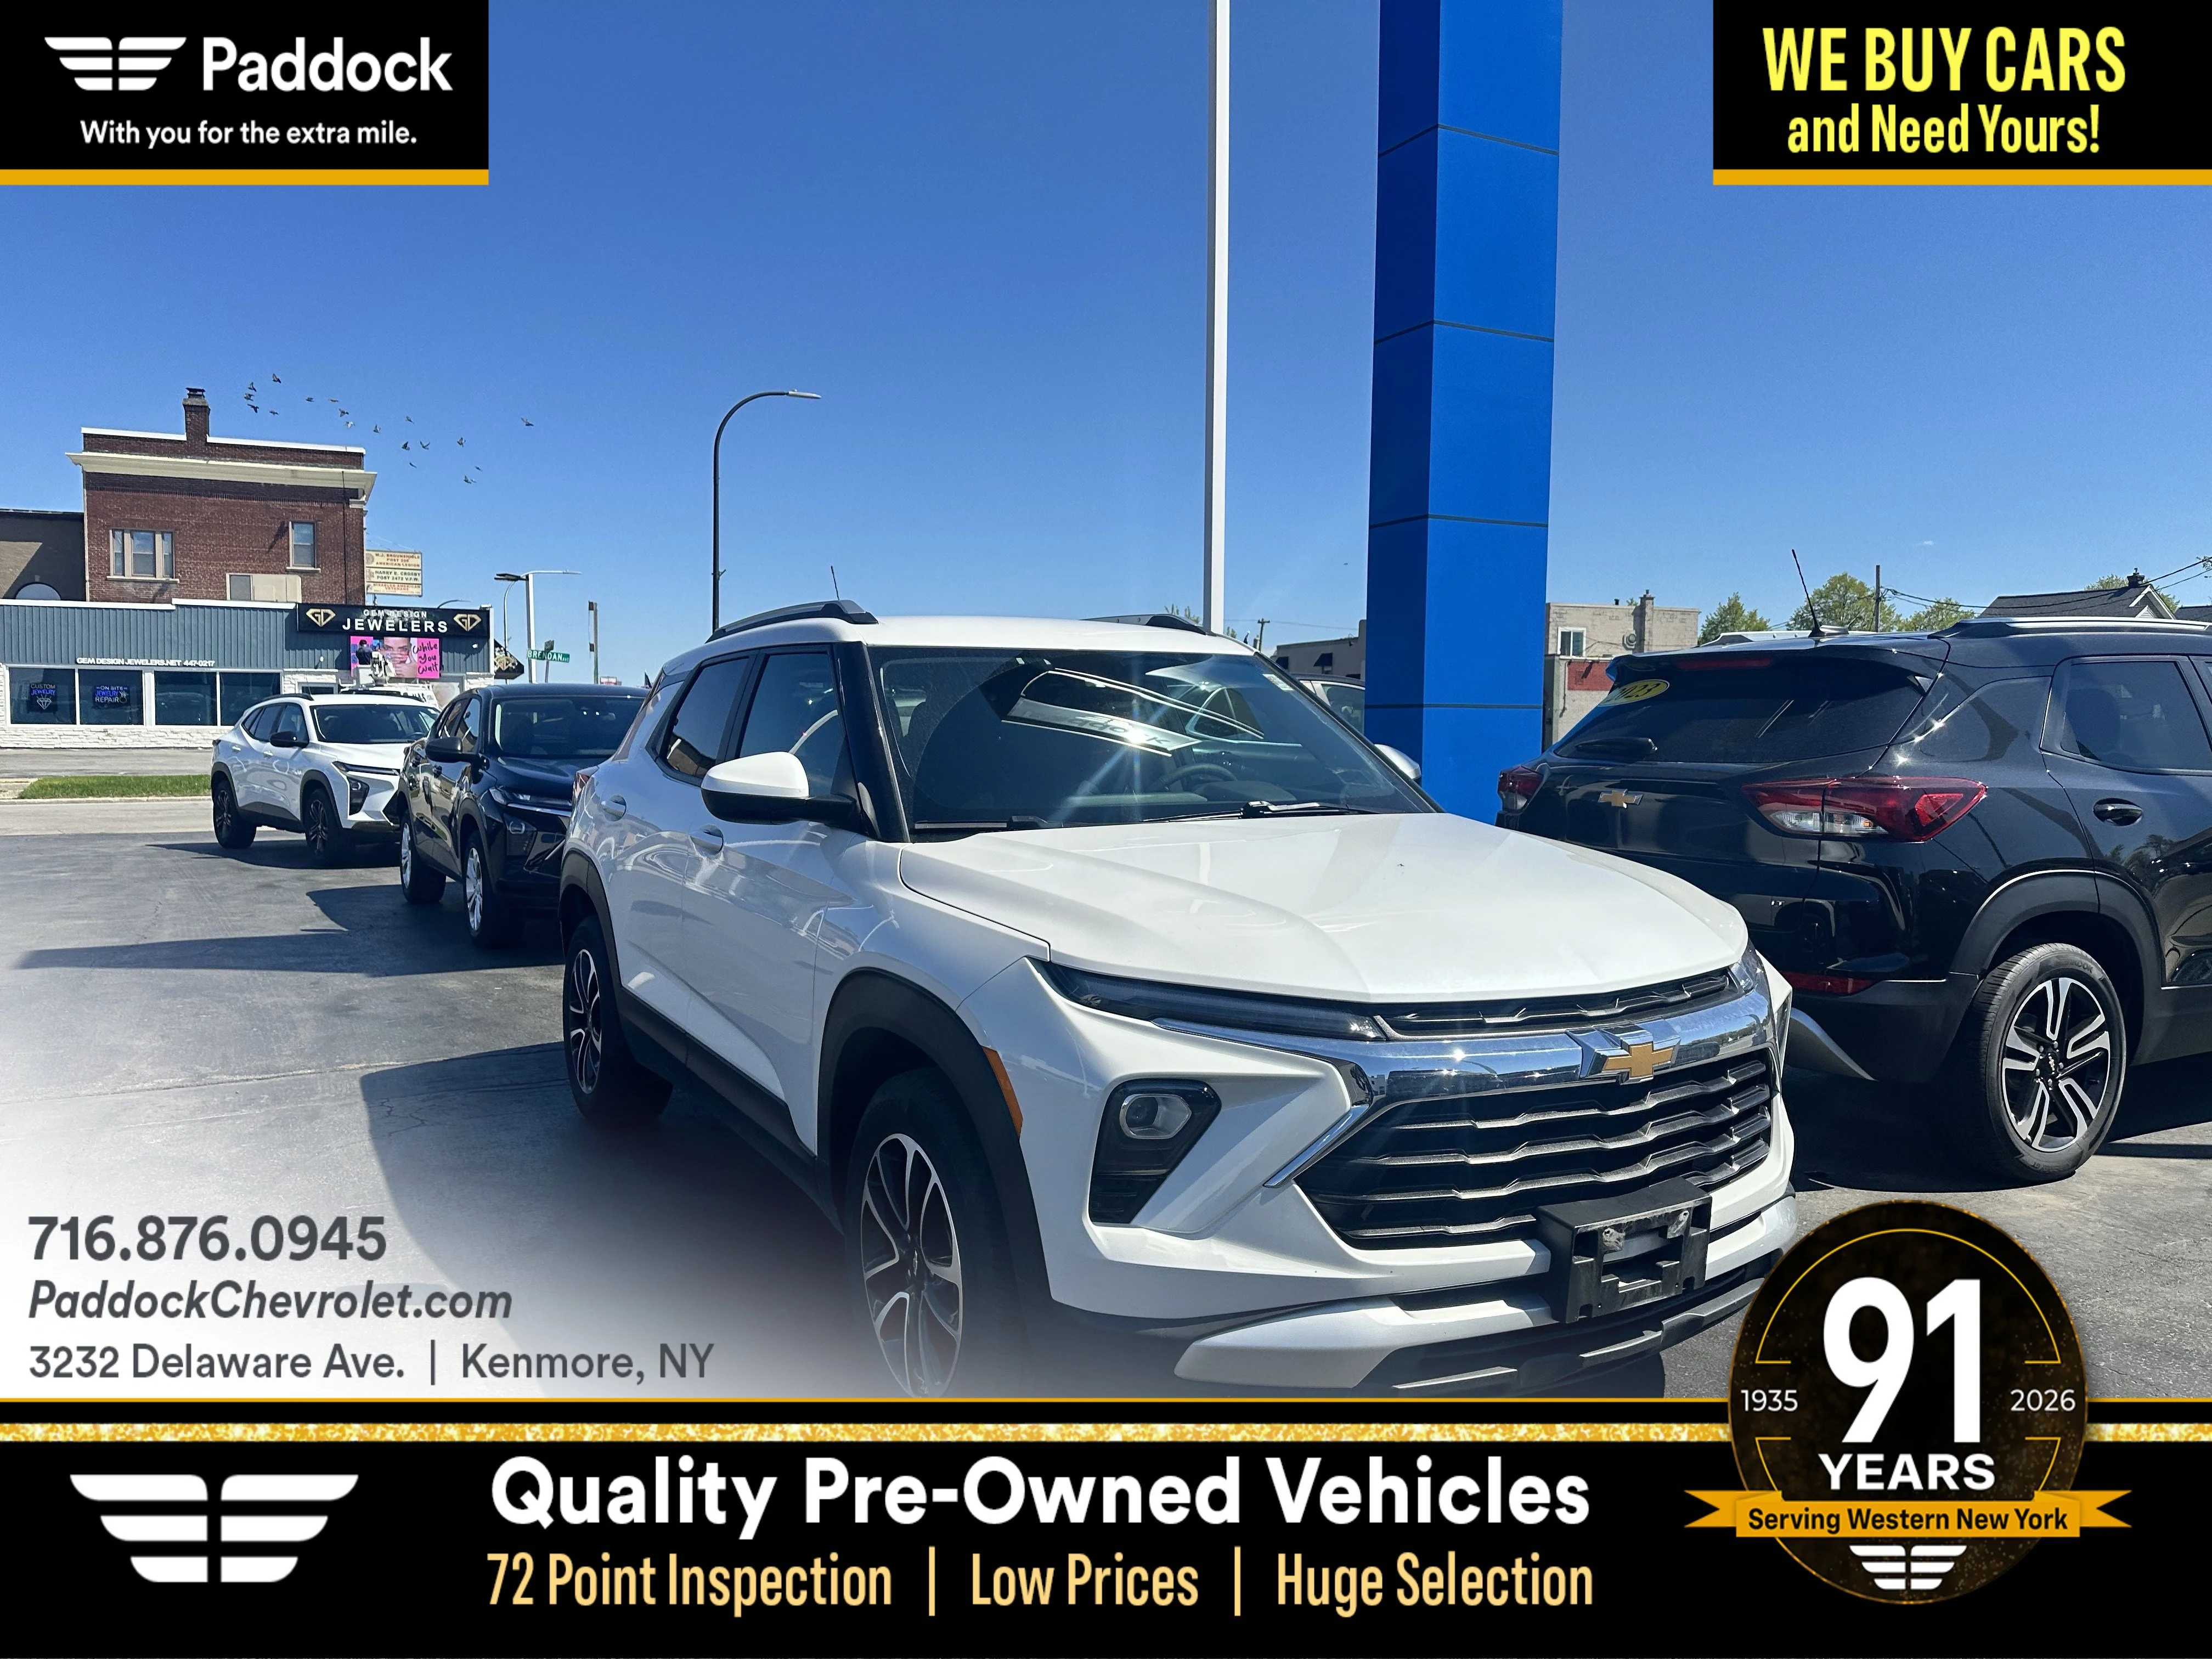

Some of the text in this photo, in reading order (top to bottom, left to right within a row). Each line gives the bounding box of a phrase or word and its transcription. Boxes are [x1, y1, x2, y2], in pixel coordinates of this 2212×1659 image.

[363, 609, 427, 618] GEM DESIGN
[342, 618, 448, 633] JEWELERS
[527, 650, 562, 662] BRENDAN
[125, 658, 182, 667] JEWELERS.NET
